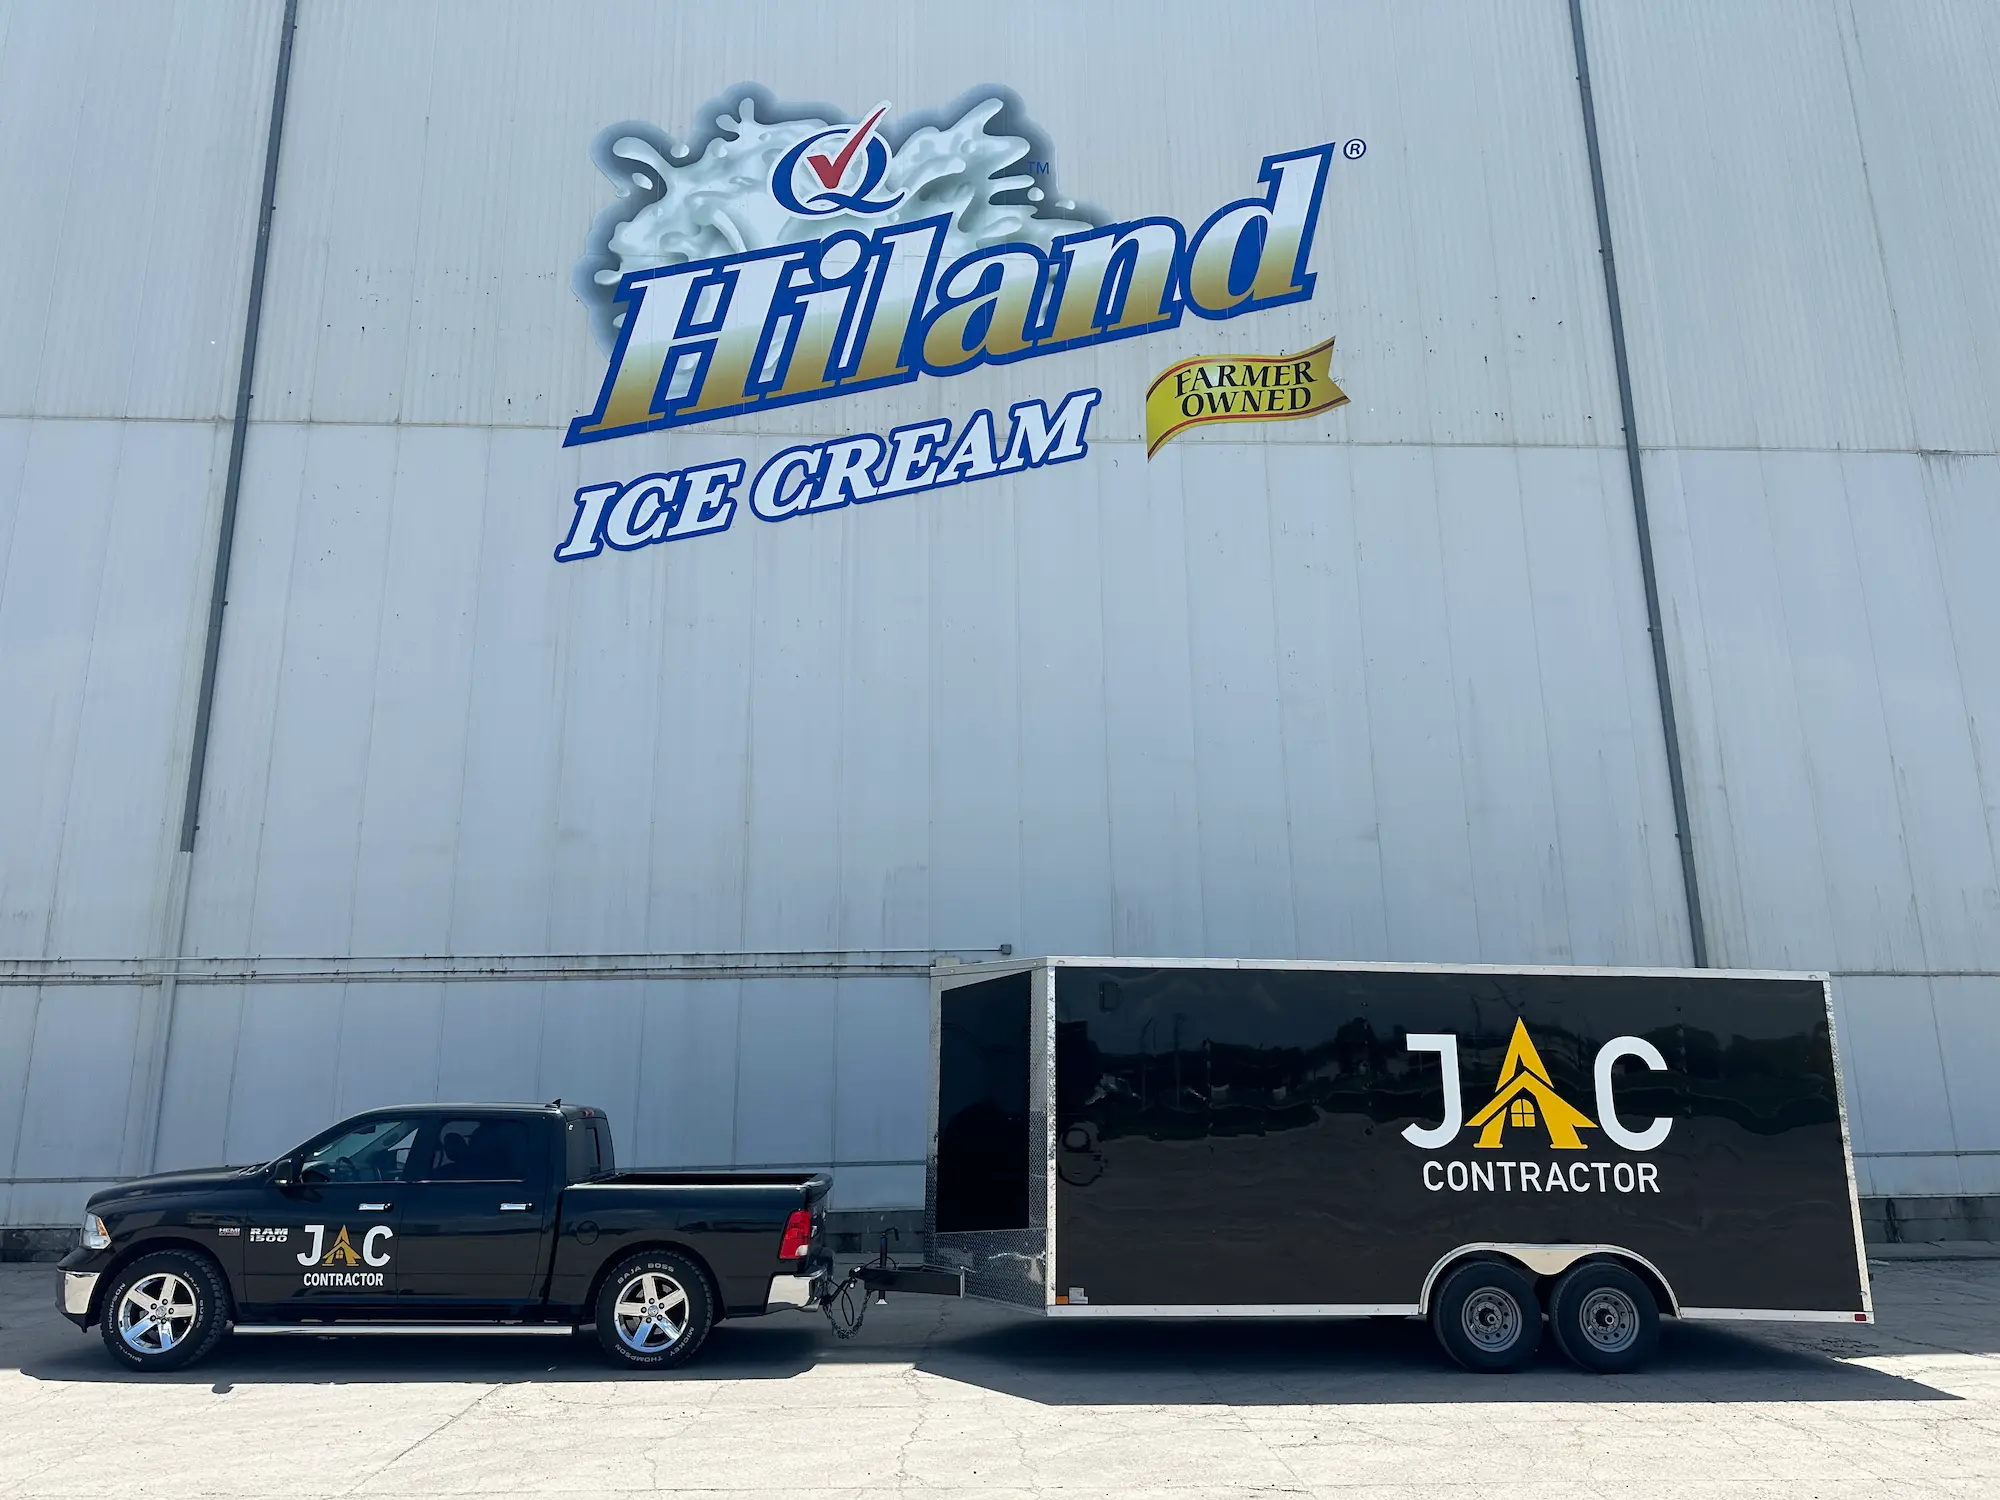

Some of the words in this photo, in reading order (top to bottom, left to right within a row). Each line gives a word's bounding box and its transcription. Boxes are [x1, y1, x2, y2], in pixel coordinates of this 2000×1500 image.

[563, 142, 1336, 448] Hiland
[1174, 361, 1317, 398] FARMER
[1181, 387, 1311, 417] OWNED
[554, 458, 746, 563] ICE
[749, 387, 1102, 523] CREAM
[1401, 1016, 1673, 1151] JAC
[1423, 1160, 1661, 1193] CONTRACTOR
[297, 1224, 394, 1267] JAC
[303, 1272, 384, 1287] CONTRACTOR
[617, 1265, 642, 1284] BAJA
[647, 1262, 675, 1272] BOSS
[614, 1343, 663, 1363] THOMPSON
[669, 1326, 695, 1357] MICKEY
